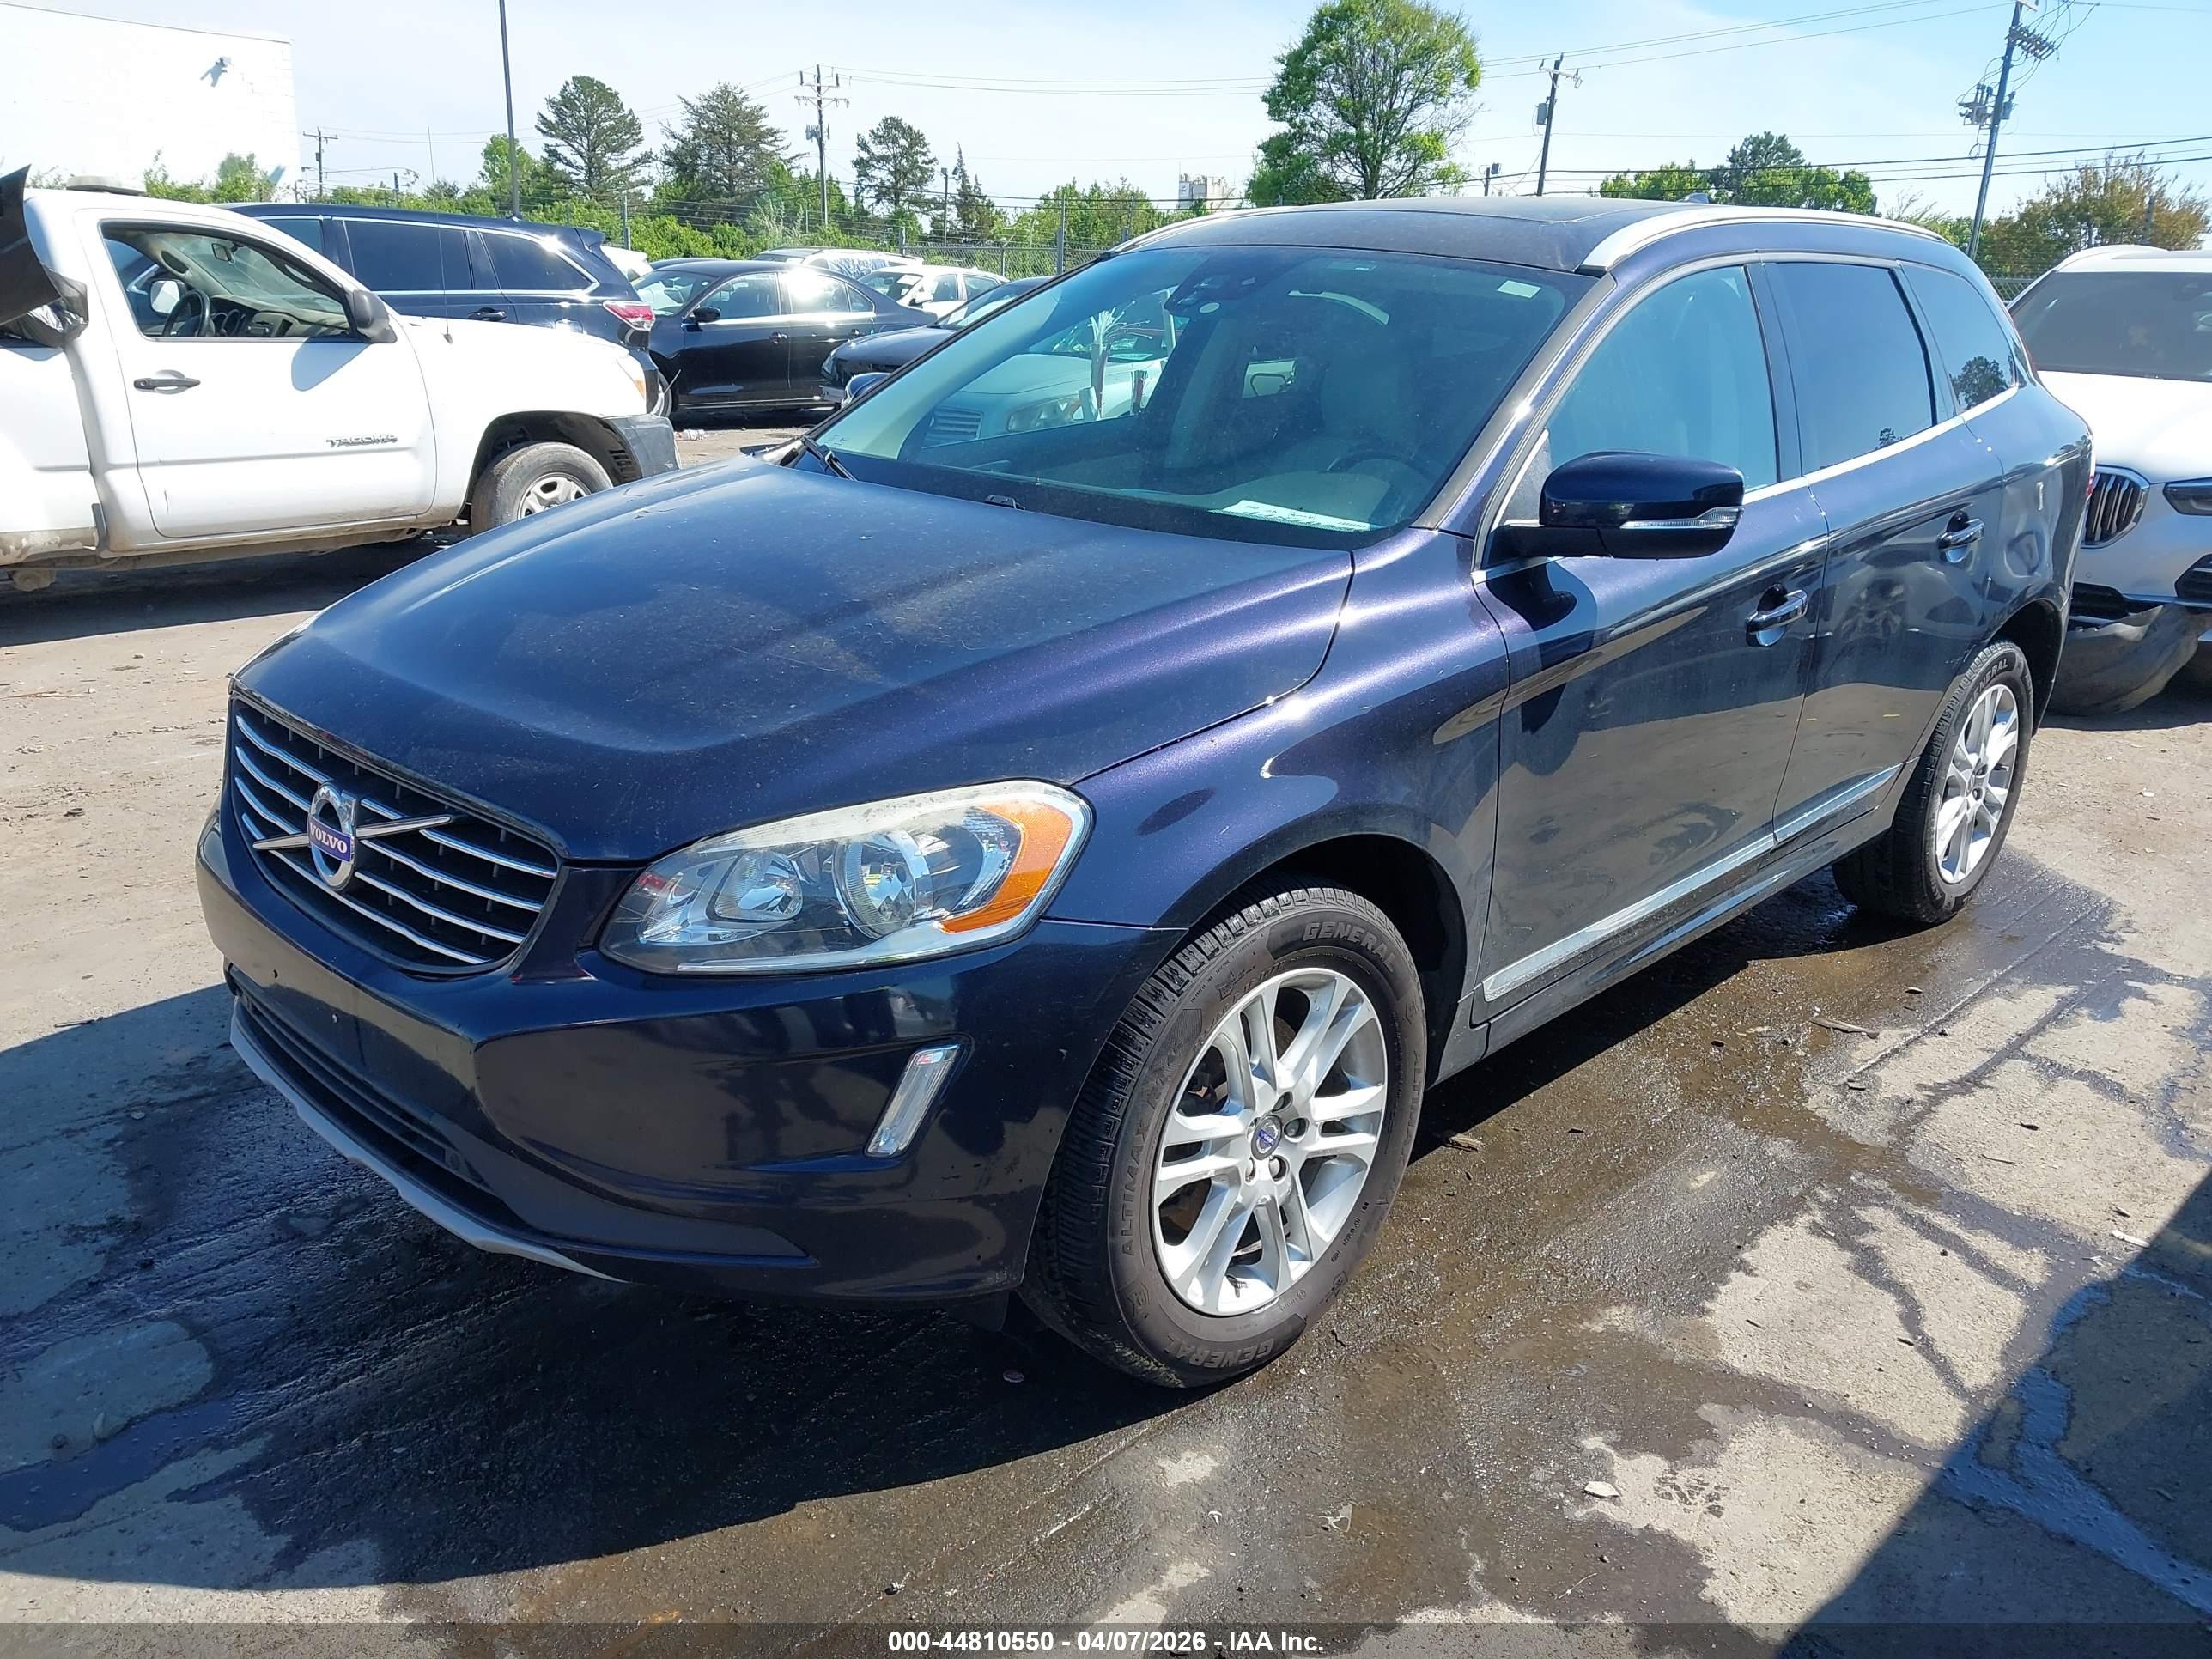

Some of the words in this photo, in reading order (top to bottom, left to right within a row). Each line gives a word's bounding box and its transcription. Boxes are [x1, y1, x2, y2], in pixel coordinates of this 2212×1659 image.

[325, 433, 398, 447] TACOMA
[310, 822, 348, 854] VOLVO
[1302, 921, 1395, 973] GENERAL
[1121, 1119, 1150, 1256] ALTIMAX
[1164, 1334, 1275, 1369] GENERAL
